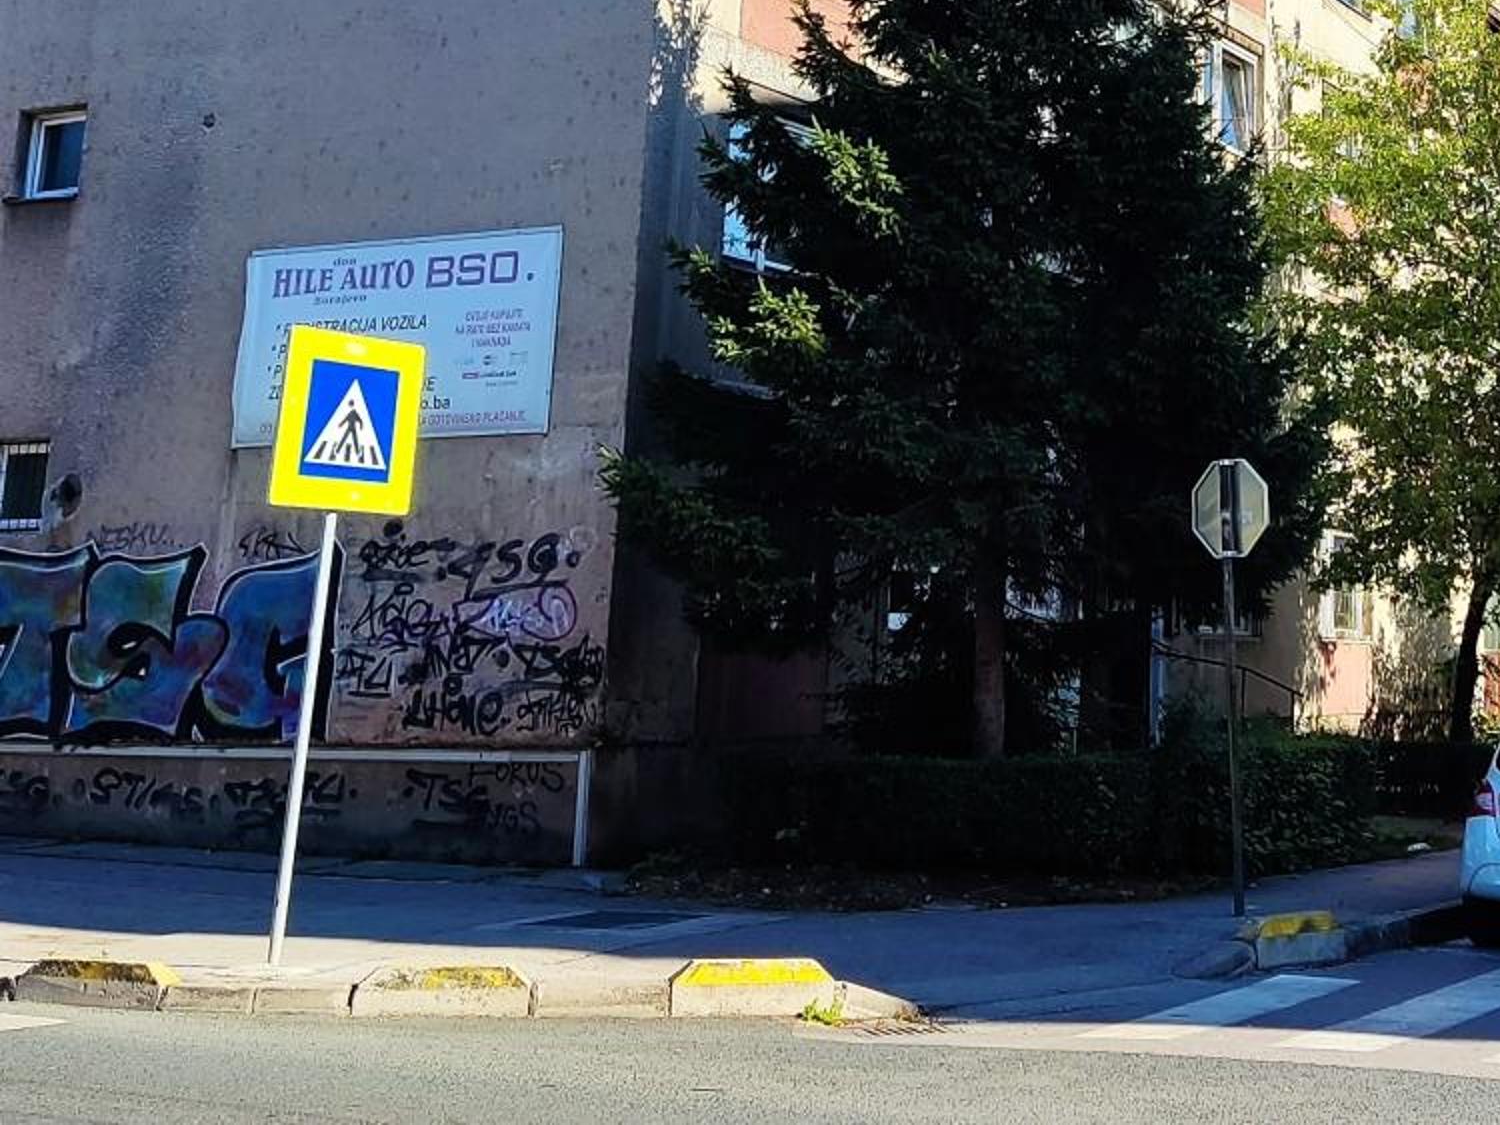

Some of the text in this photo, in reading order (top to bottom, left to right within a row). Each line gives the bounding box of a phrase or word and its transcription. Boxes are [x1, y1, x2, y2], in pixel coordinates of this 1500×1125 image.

[272, 268, 334, 298] HILE
[340, 258, 415, 290] AUTO
[380, 314, 428, 333] VOZILA
